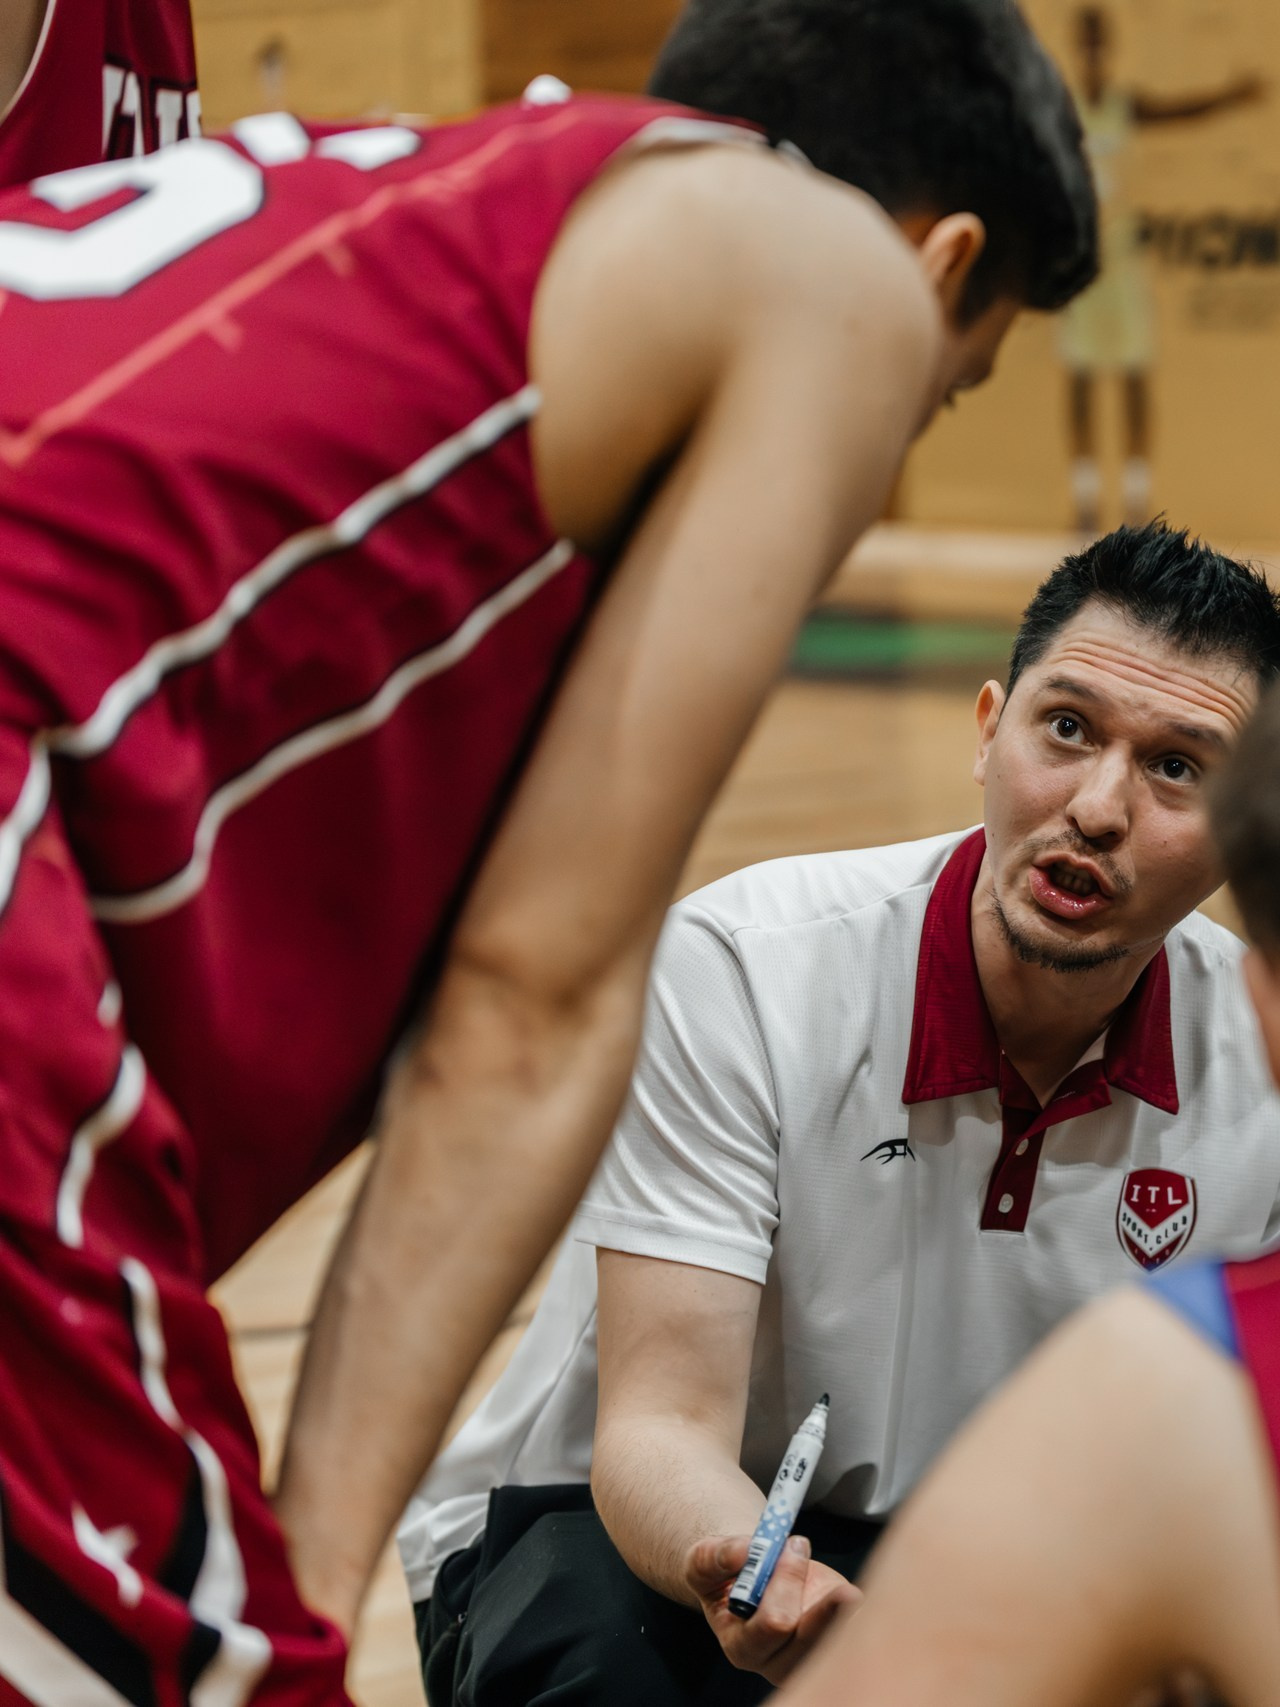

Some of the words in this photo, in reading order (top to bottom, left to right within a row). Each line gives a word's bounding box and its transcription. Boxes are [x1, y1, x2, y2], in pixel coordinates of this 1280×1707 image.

[1130, 1184, 1183, 1206] ITL
[1122, 1212, 1149, 1244] SPORT
[1155, 1215, 1187, 1245] CLUB
